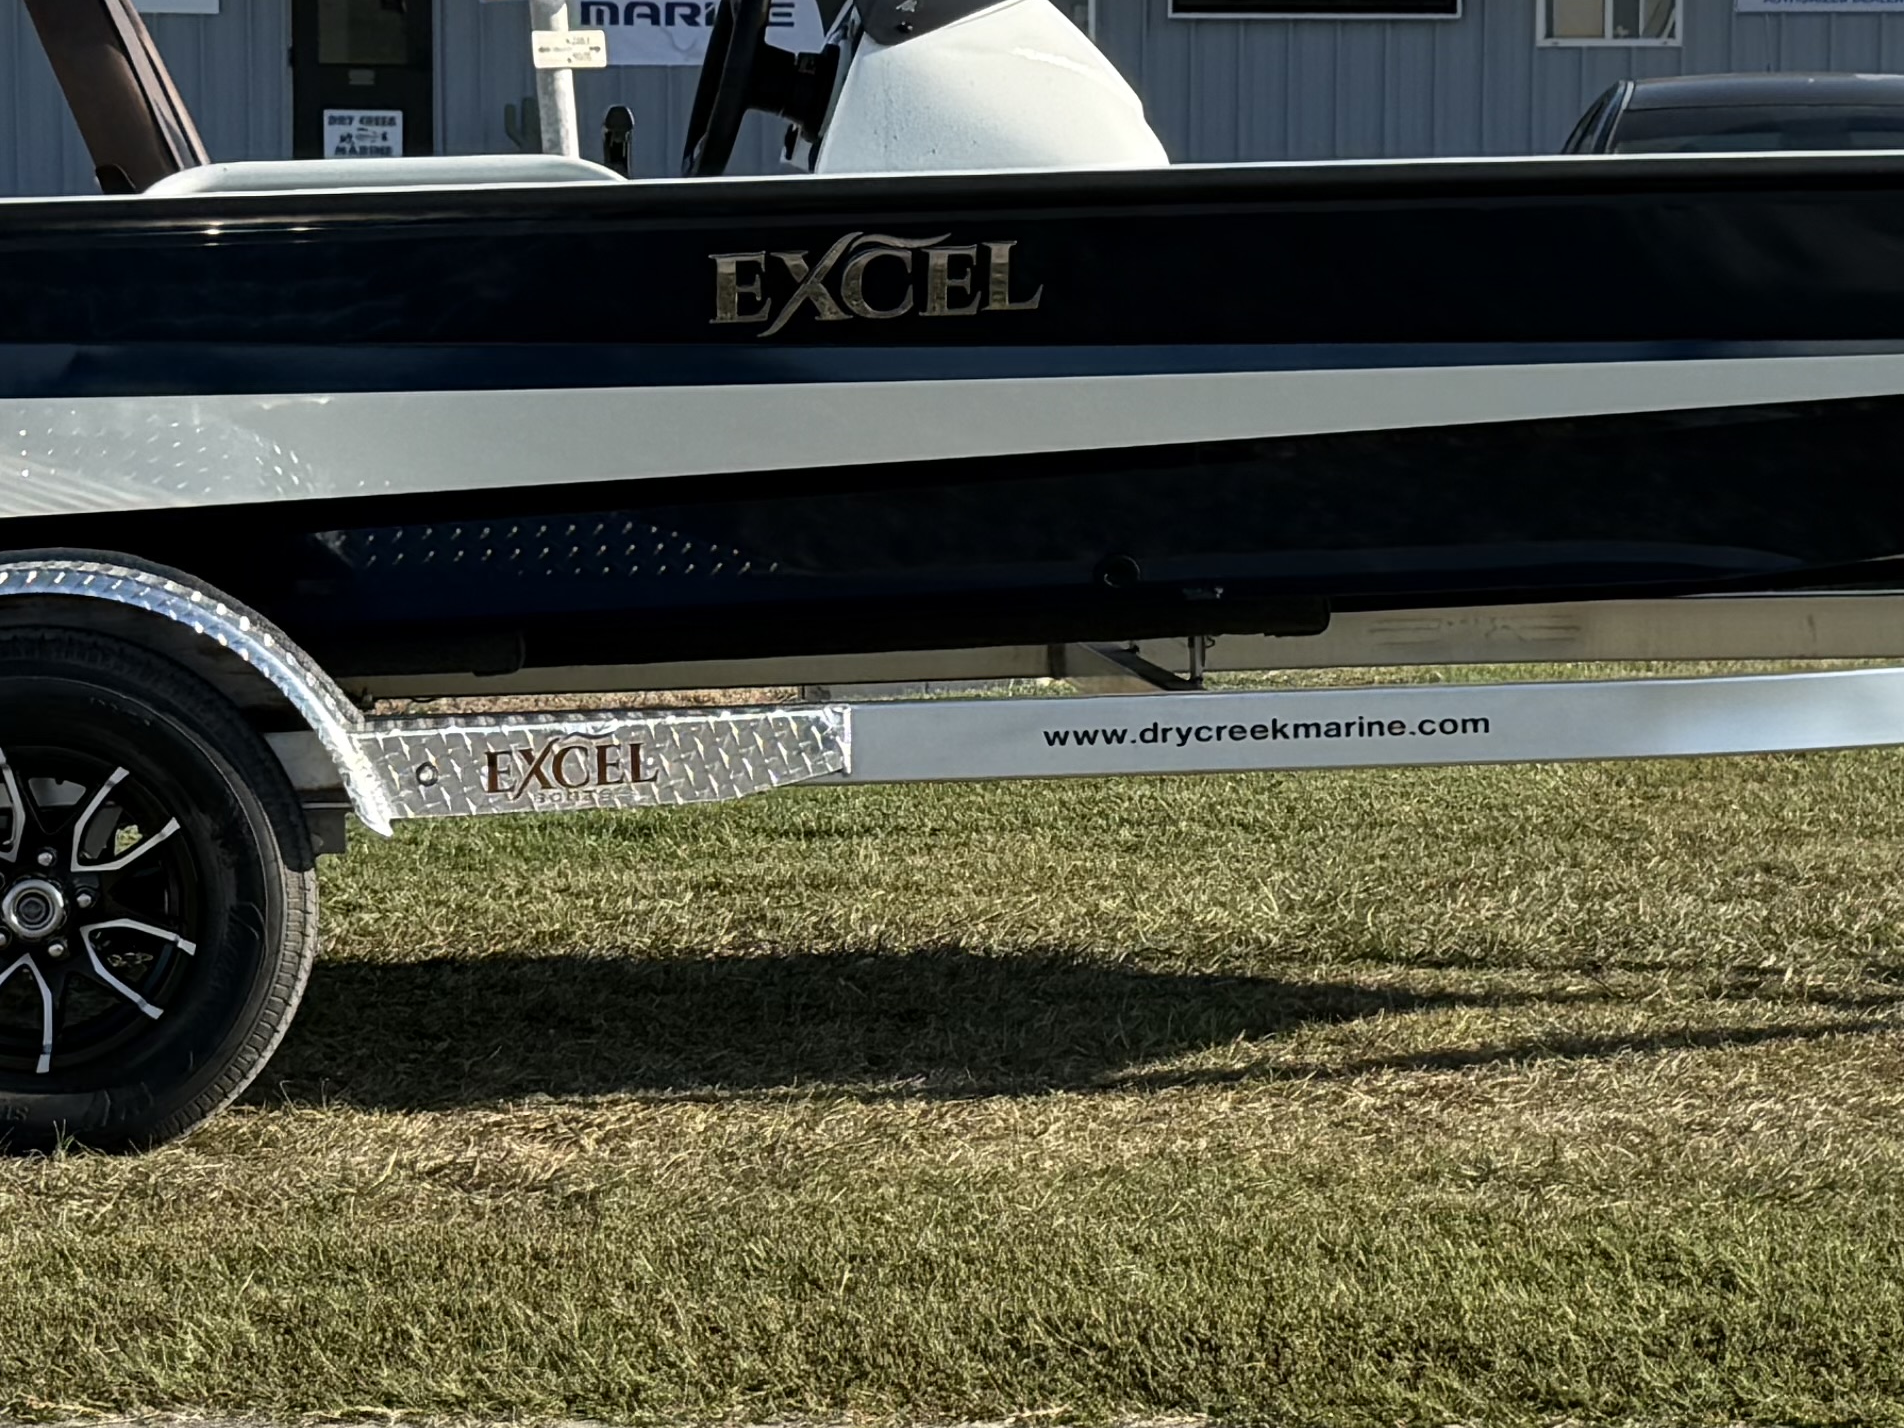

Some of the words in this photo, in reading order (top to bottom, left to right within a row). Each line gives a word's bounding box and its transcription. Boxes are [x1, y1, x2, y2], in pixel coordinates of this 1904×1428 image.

[581, 0, 795, 27] MARIE
[708, 232, 1043, 337] EXCEL
[1043, 715, 1490, 748] www.drycreekmarine.com
[484, 732, 659, 800] EXCEL
